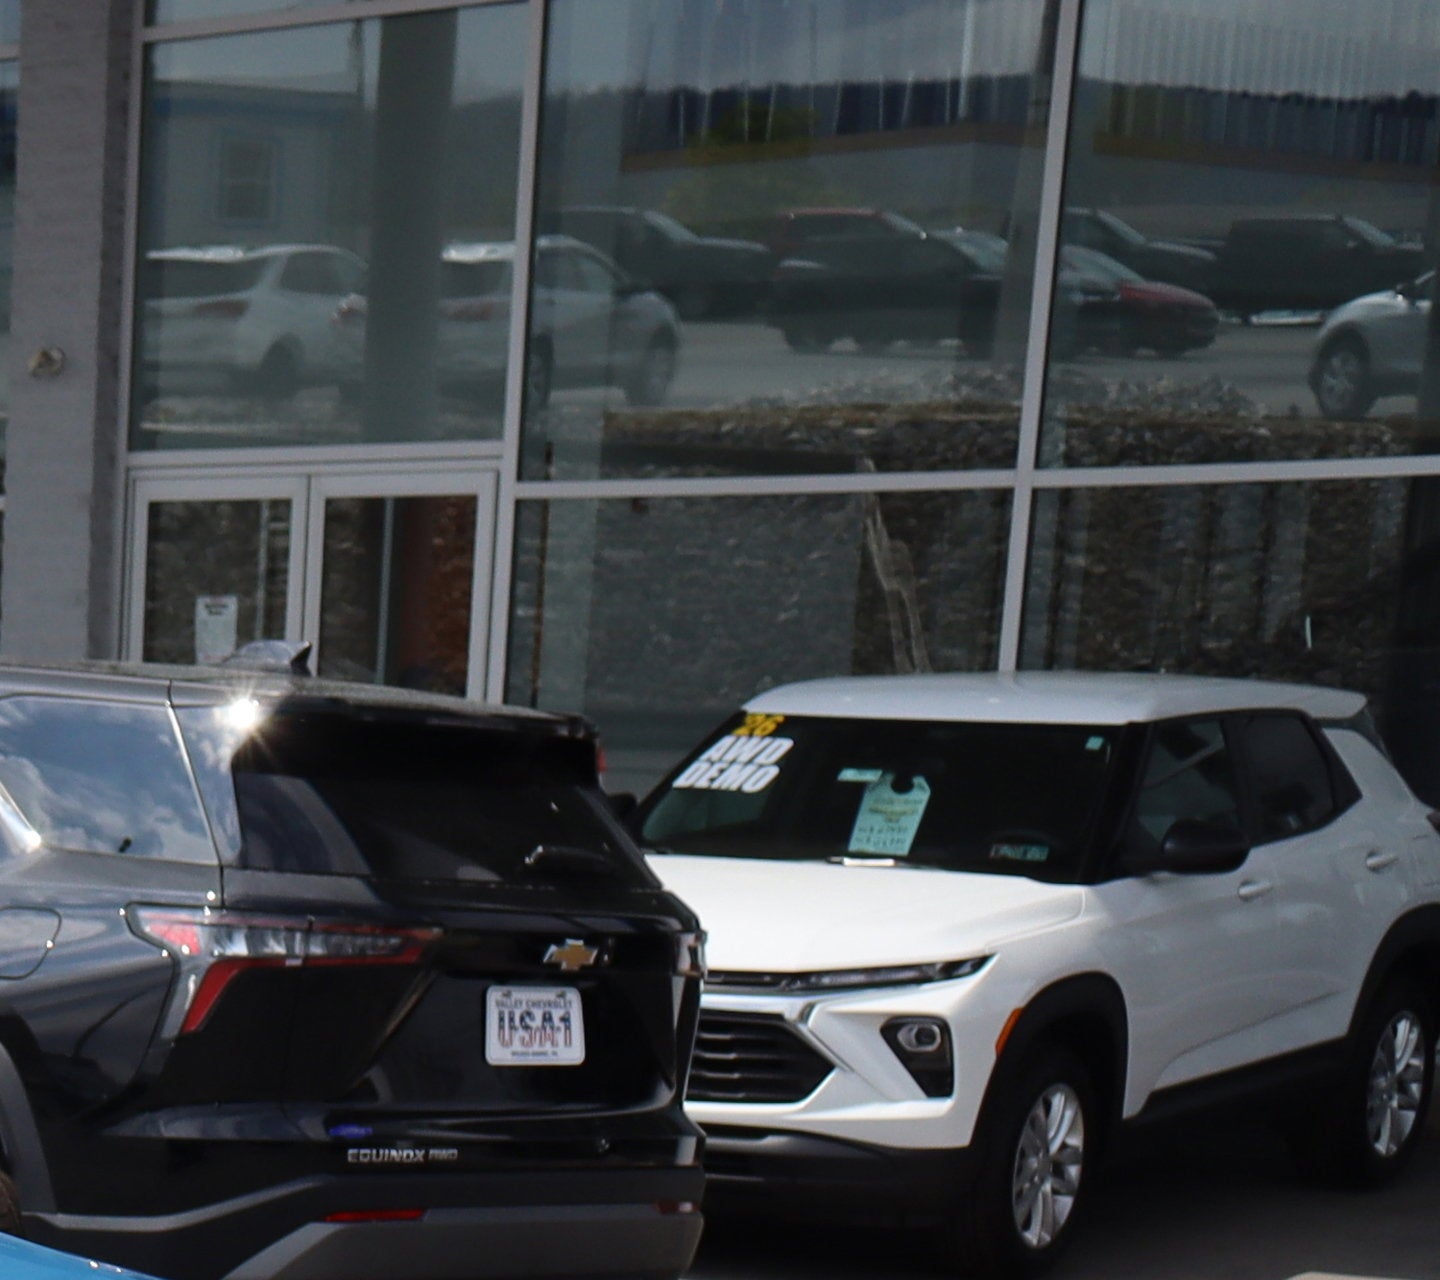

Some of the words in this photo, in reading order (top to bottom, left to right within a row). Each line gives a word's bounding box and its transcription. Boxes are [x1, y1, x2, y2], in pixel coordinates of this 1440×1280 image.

[699, 735, 794, 765] AWD
[672, 761, 780, 793] DEMO
[347, 1148, 425, 1163] EQUINOX
